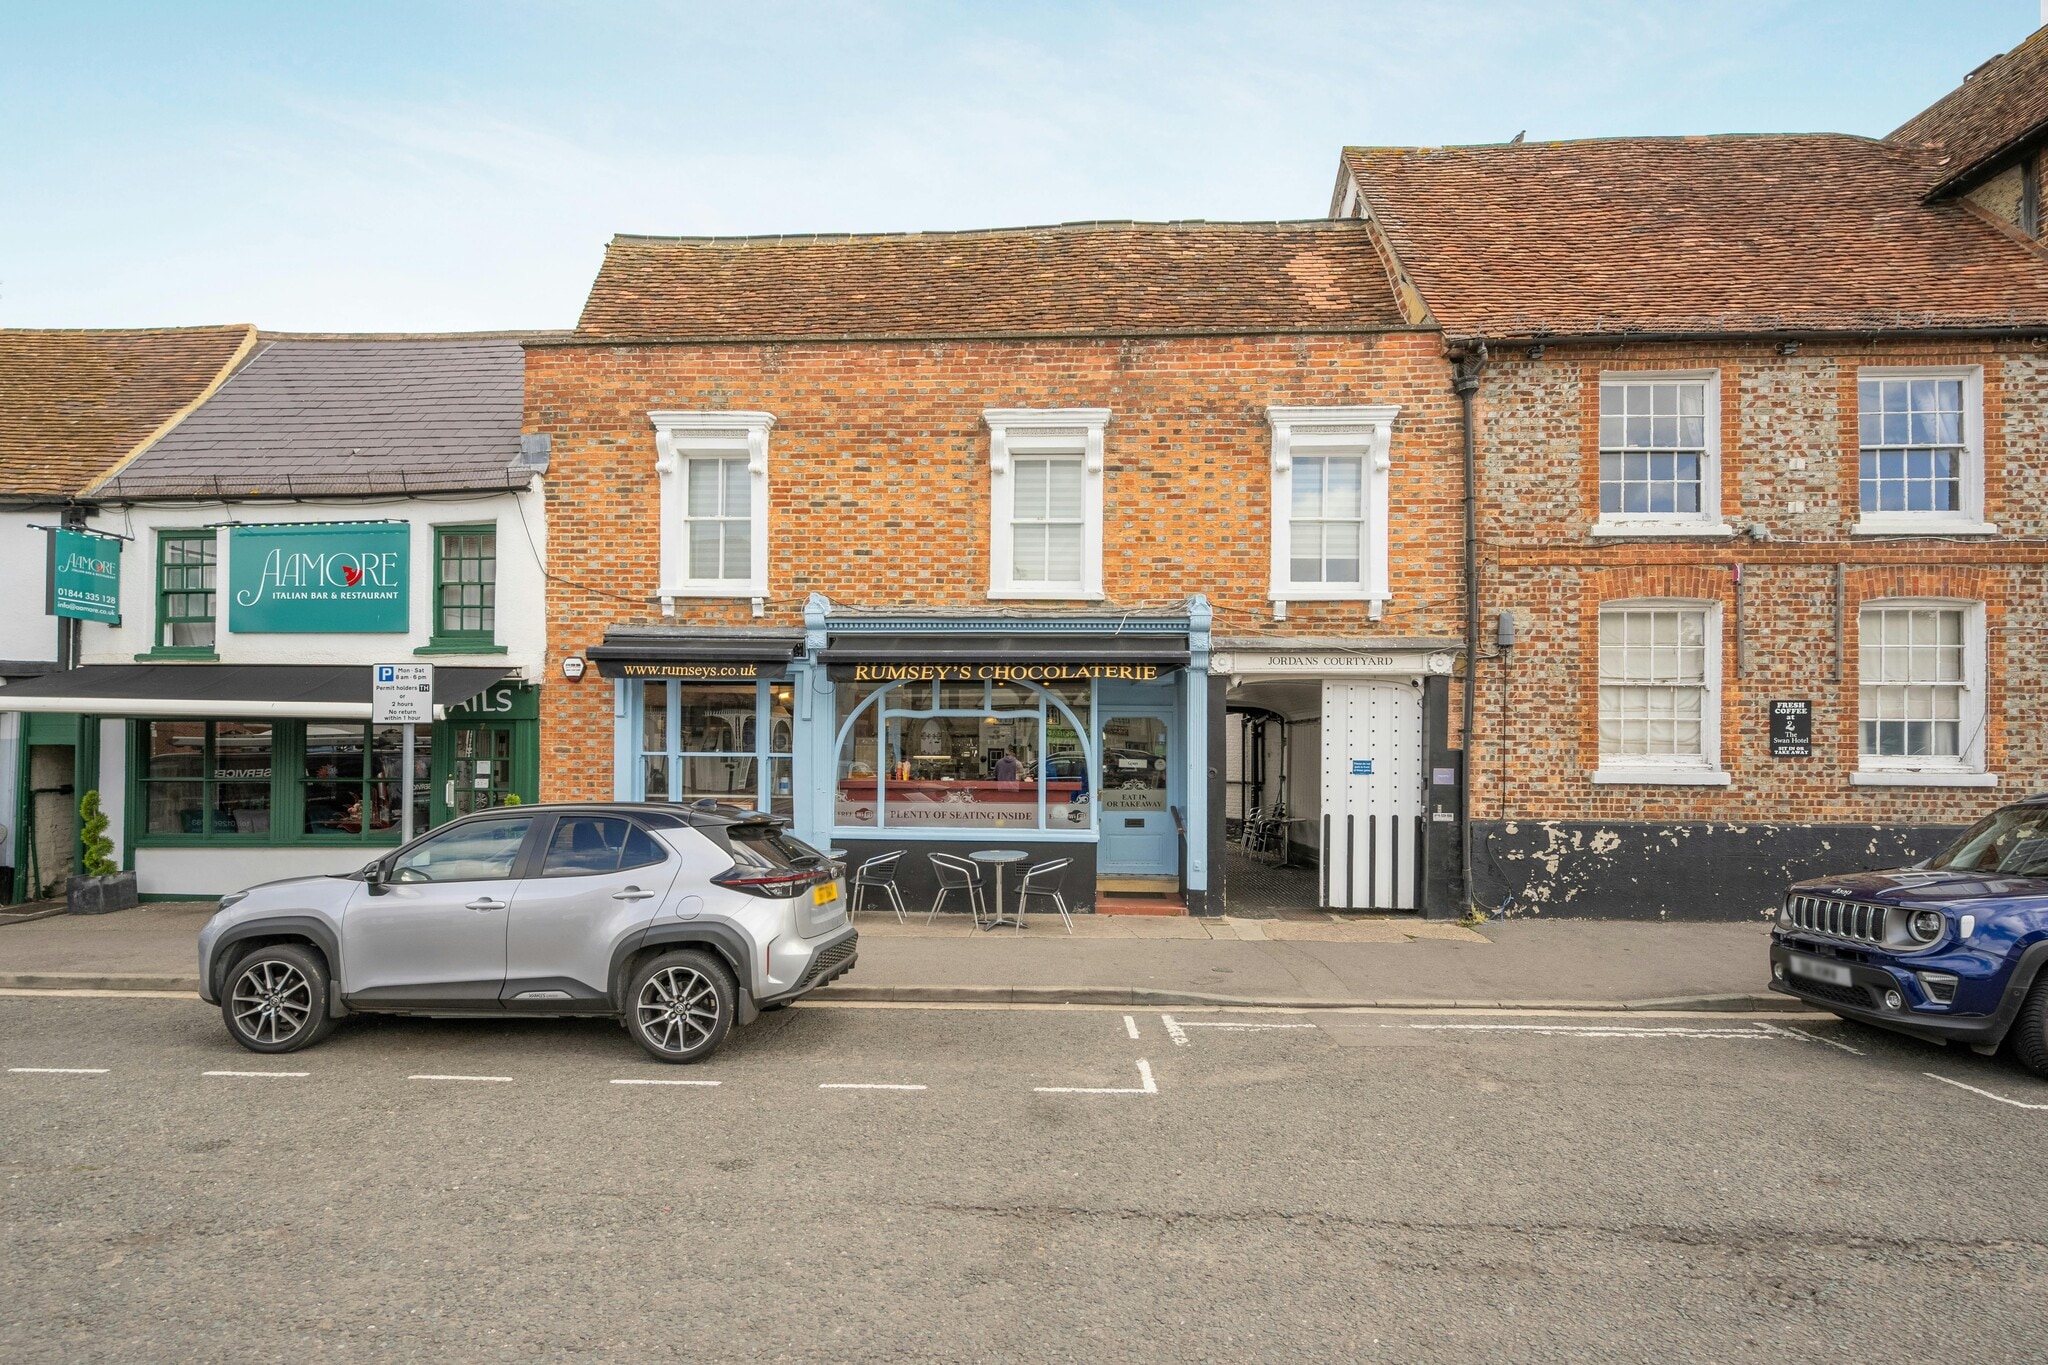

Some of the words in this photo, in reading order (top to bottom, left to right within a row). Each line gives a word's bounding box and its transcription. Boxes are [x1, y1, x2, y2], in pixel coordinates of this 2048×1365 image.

[58, 553, 116, 576] AAMORE
[237, 549, 398, 606] AAMORE
[58, 588, 83, 599] 01844
[84, 592, 100, 601] 335
[102, 595, 116, 604] 128
[340, 592, 398, 600] RESTAURANT
[58, 601, 115, 616] info@aamore.co.uk
[1268, 657, 1318, 665] JORDANS
[1324, 657, 1393, 666] COURTYARD
[624, 664, 758, 679] www.rumseys.co.uk
[854, 666, 972, 680] RUMSEY'S
[978, 666, 1158, 680] CHOCOLATERIE
[890, 810, 931, 818] PLENTY
[949, 811, 994, 820] SEATING
[997, 812, 1032, 820] INSIDE
